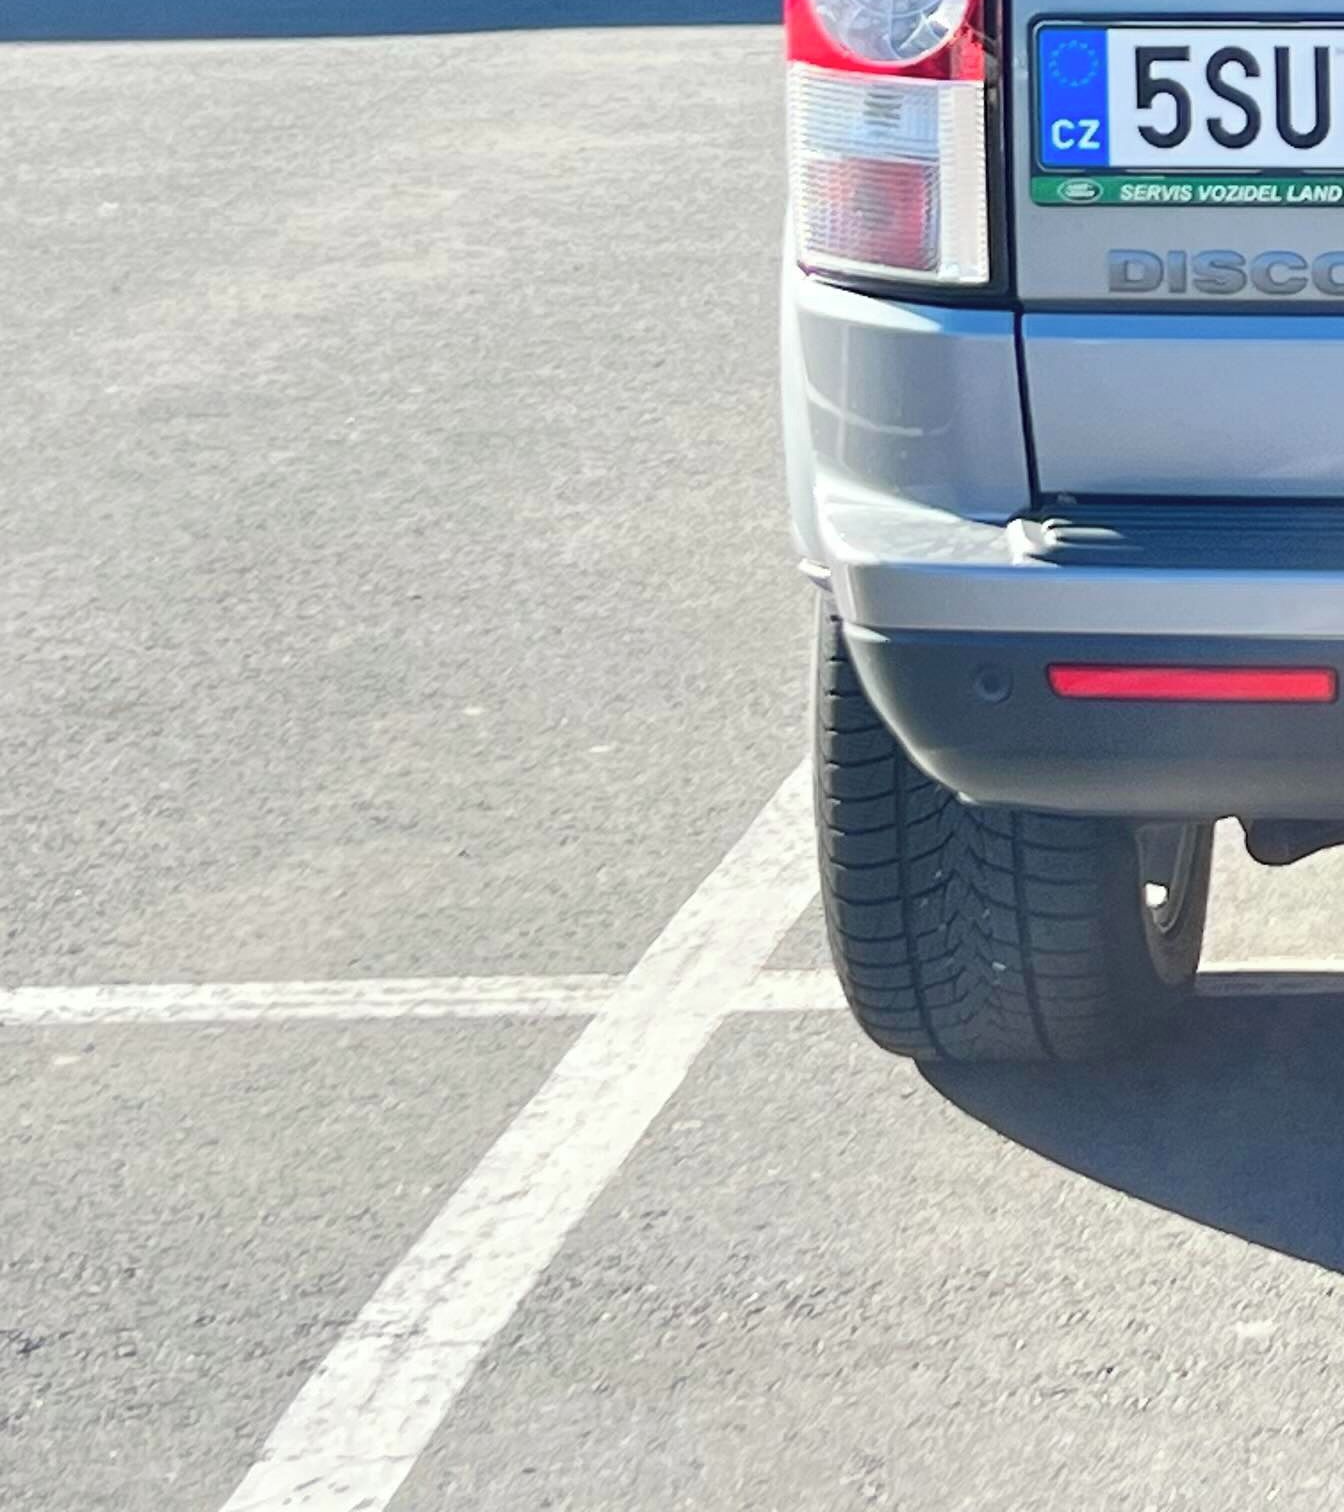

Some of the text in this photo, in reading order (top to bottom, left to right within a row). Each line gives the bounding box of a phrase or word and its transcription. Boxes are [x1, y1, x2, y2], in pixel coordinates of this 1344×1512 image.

[1051, 118, 1101, 151] CZ
[1133, 45, 1332, 150] 5SU
[1119, 183, 1193, 203] SERVIS
[1199, 183, 1282, 203] VOZIDEL
[1286, 183, 1343, 203] LAND
